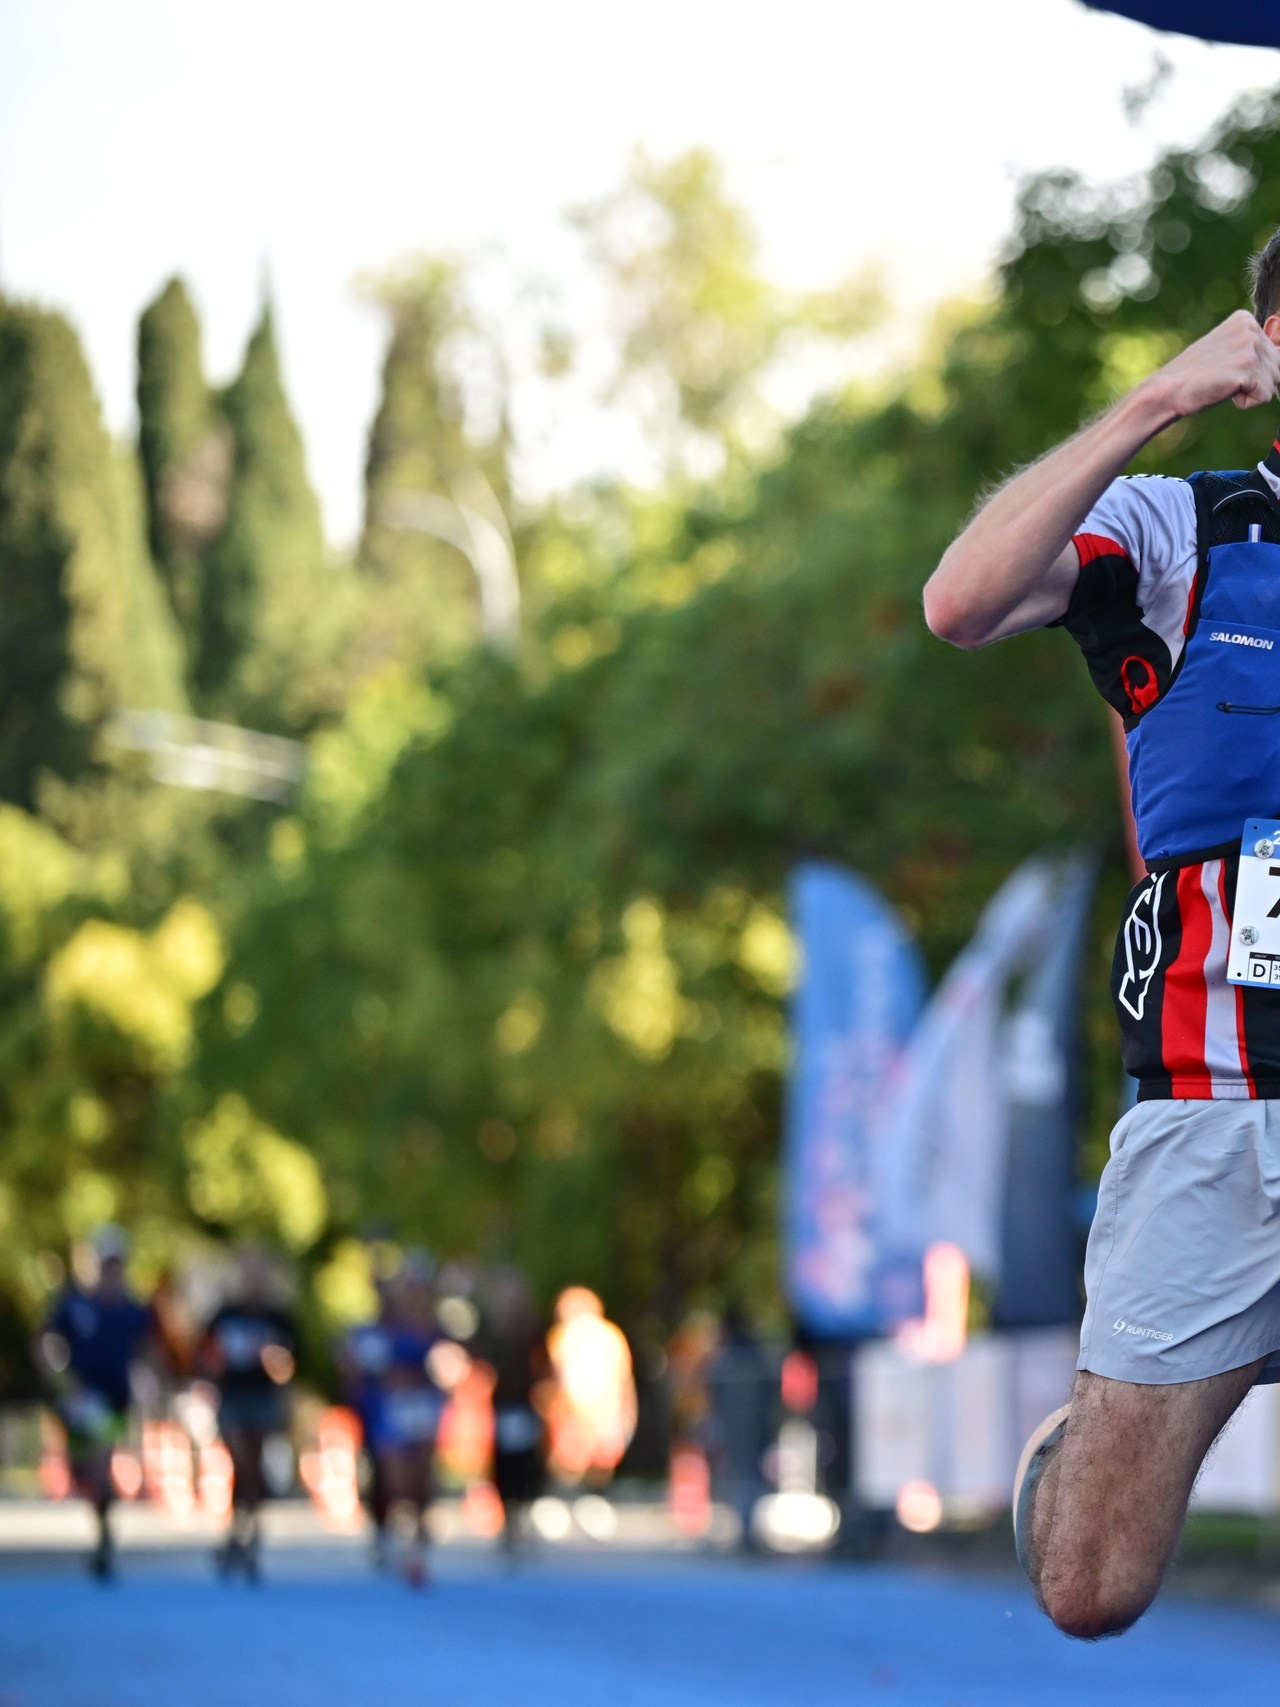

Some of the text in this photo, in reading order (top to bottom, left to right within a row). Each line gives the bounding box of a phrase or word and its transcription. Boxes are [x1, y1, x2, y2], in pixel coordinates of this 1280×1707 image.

[1209, 632, 1274, 650] SALOMON
[1253, 963, 1266, 978] D
[1126, 1325, 1174, 1342] RUNTIGER
